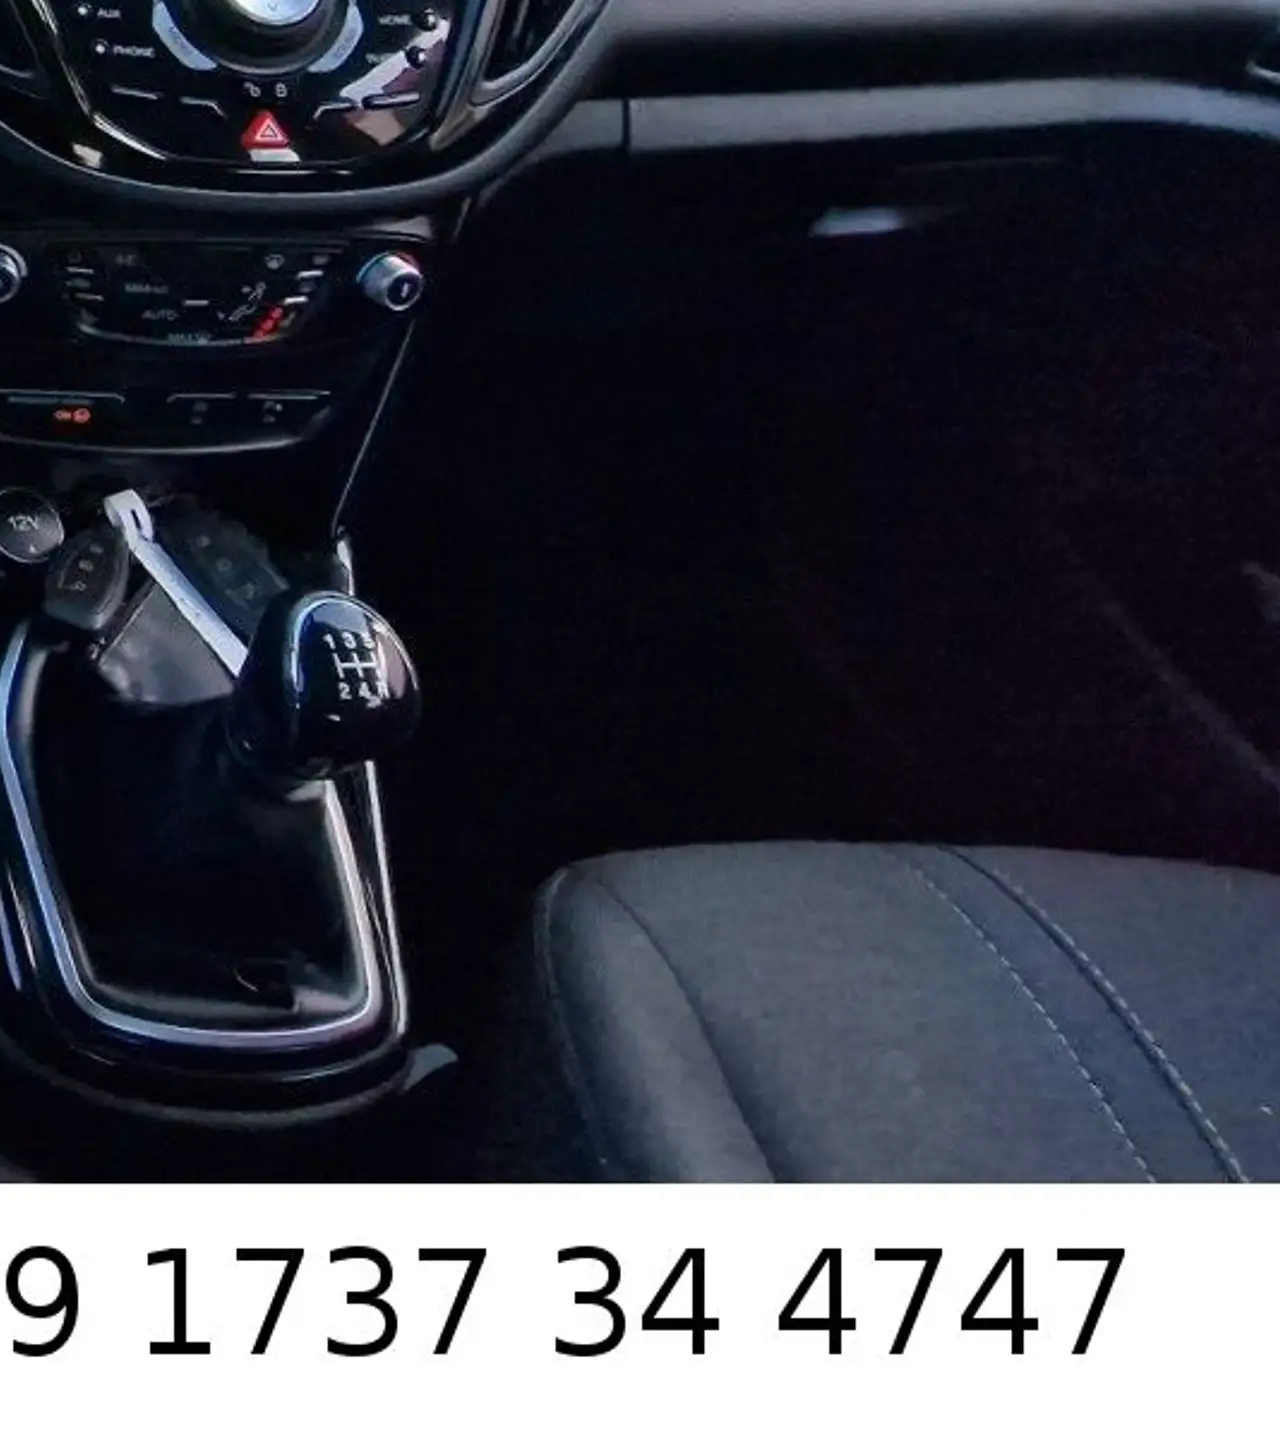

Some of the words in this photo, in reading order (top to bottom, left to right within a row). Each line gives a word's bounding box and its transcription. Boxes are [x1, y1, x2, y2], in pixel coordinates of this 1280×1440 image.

[97, 9, 121, 19] AUX
[113, 45, 155, 58] PHONE
[141, 308, 178, 320] AUTO
[323, 633, 336, 650] 1
[342, 631, 357, 649] 3
[339, 681, 352, 700] 2
[359, 681, 372, 699] 4
